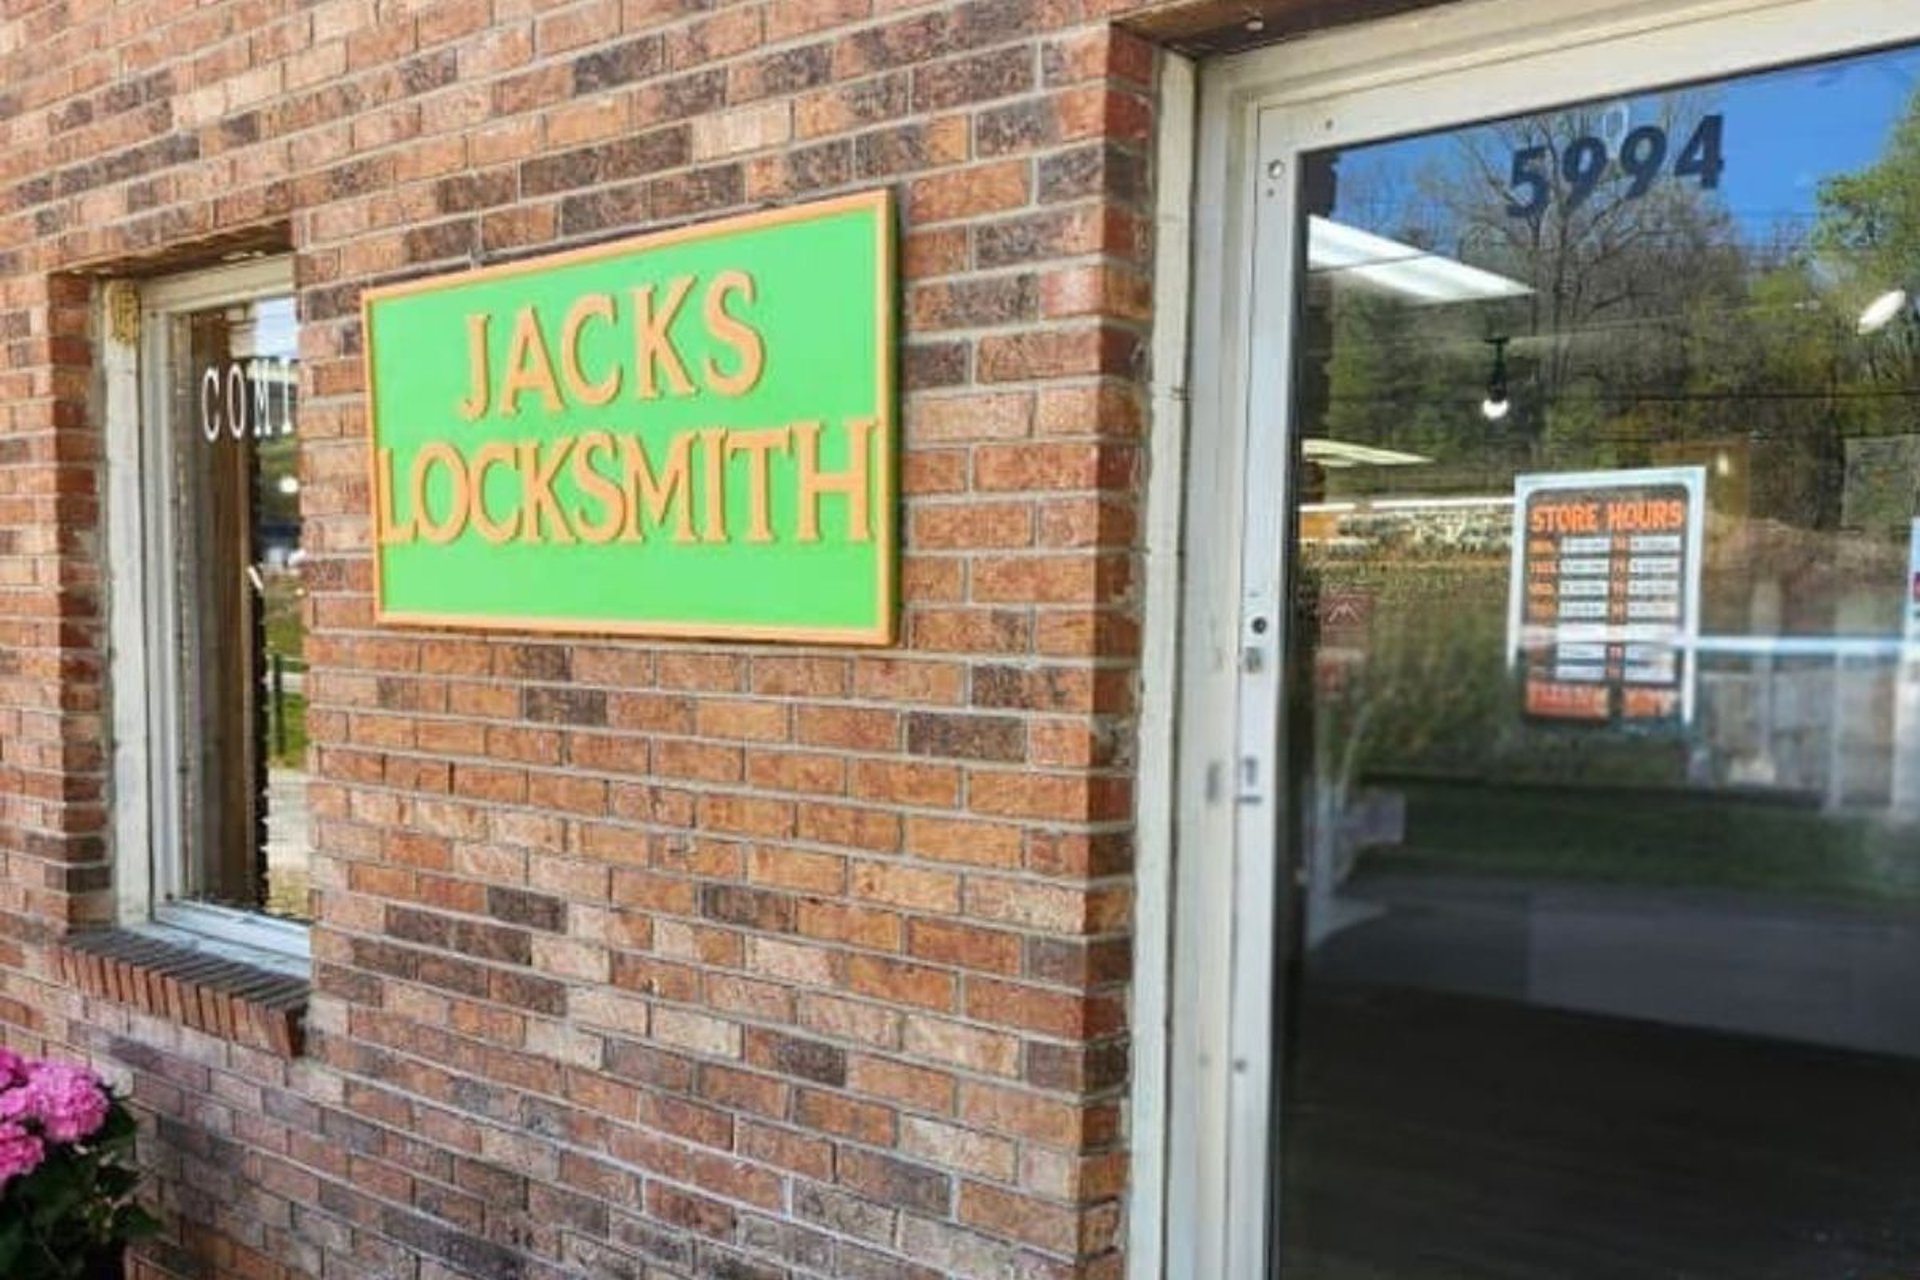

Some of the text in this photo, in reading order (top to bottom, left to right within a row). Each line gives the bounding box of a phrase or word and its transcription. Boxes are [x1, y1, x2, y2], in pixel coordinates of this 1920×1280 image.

[1506, 114, 1725, 218] 5994
[459, 270, 767, 422] JACKS
[378, 417, 880, 545] LOCKSMITH
[1530, 498, 1683, 533] STORE HOURS
